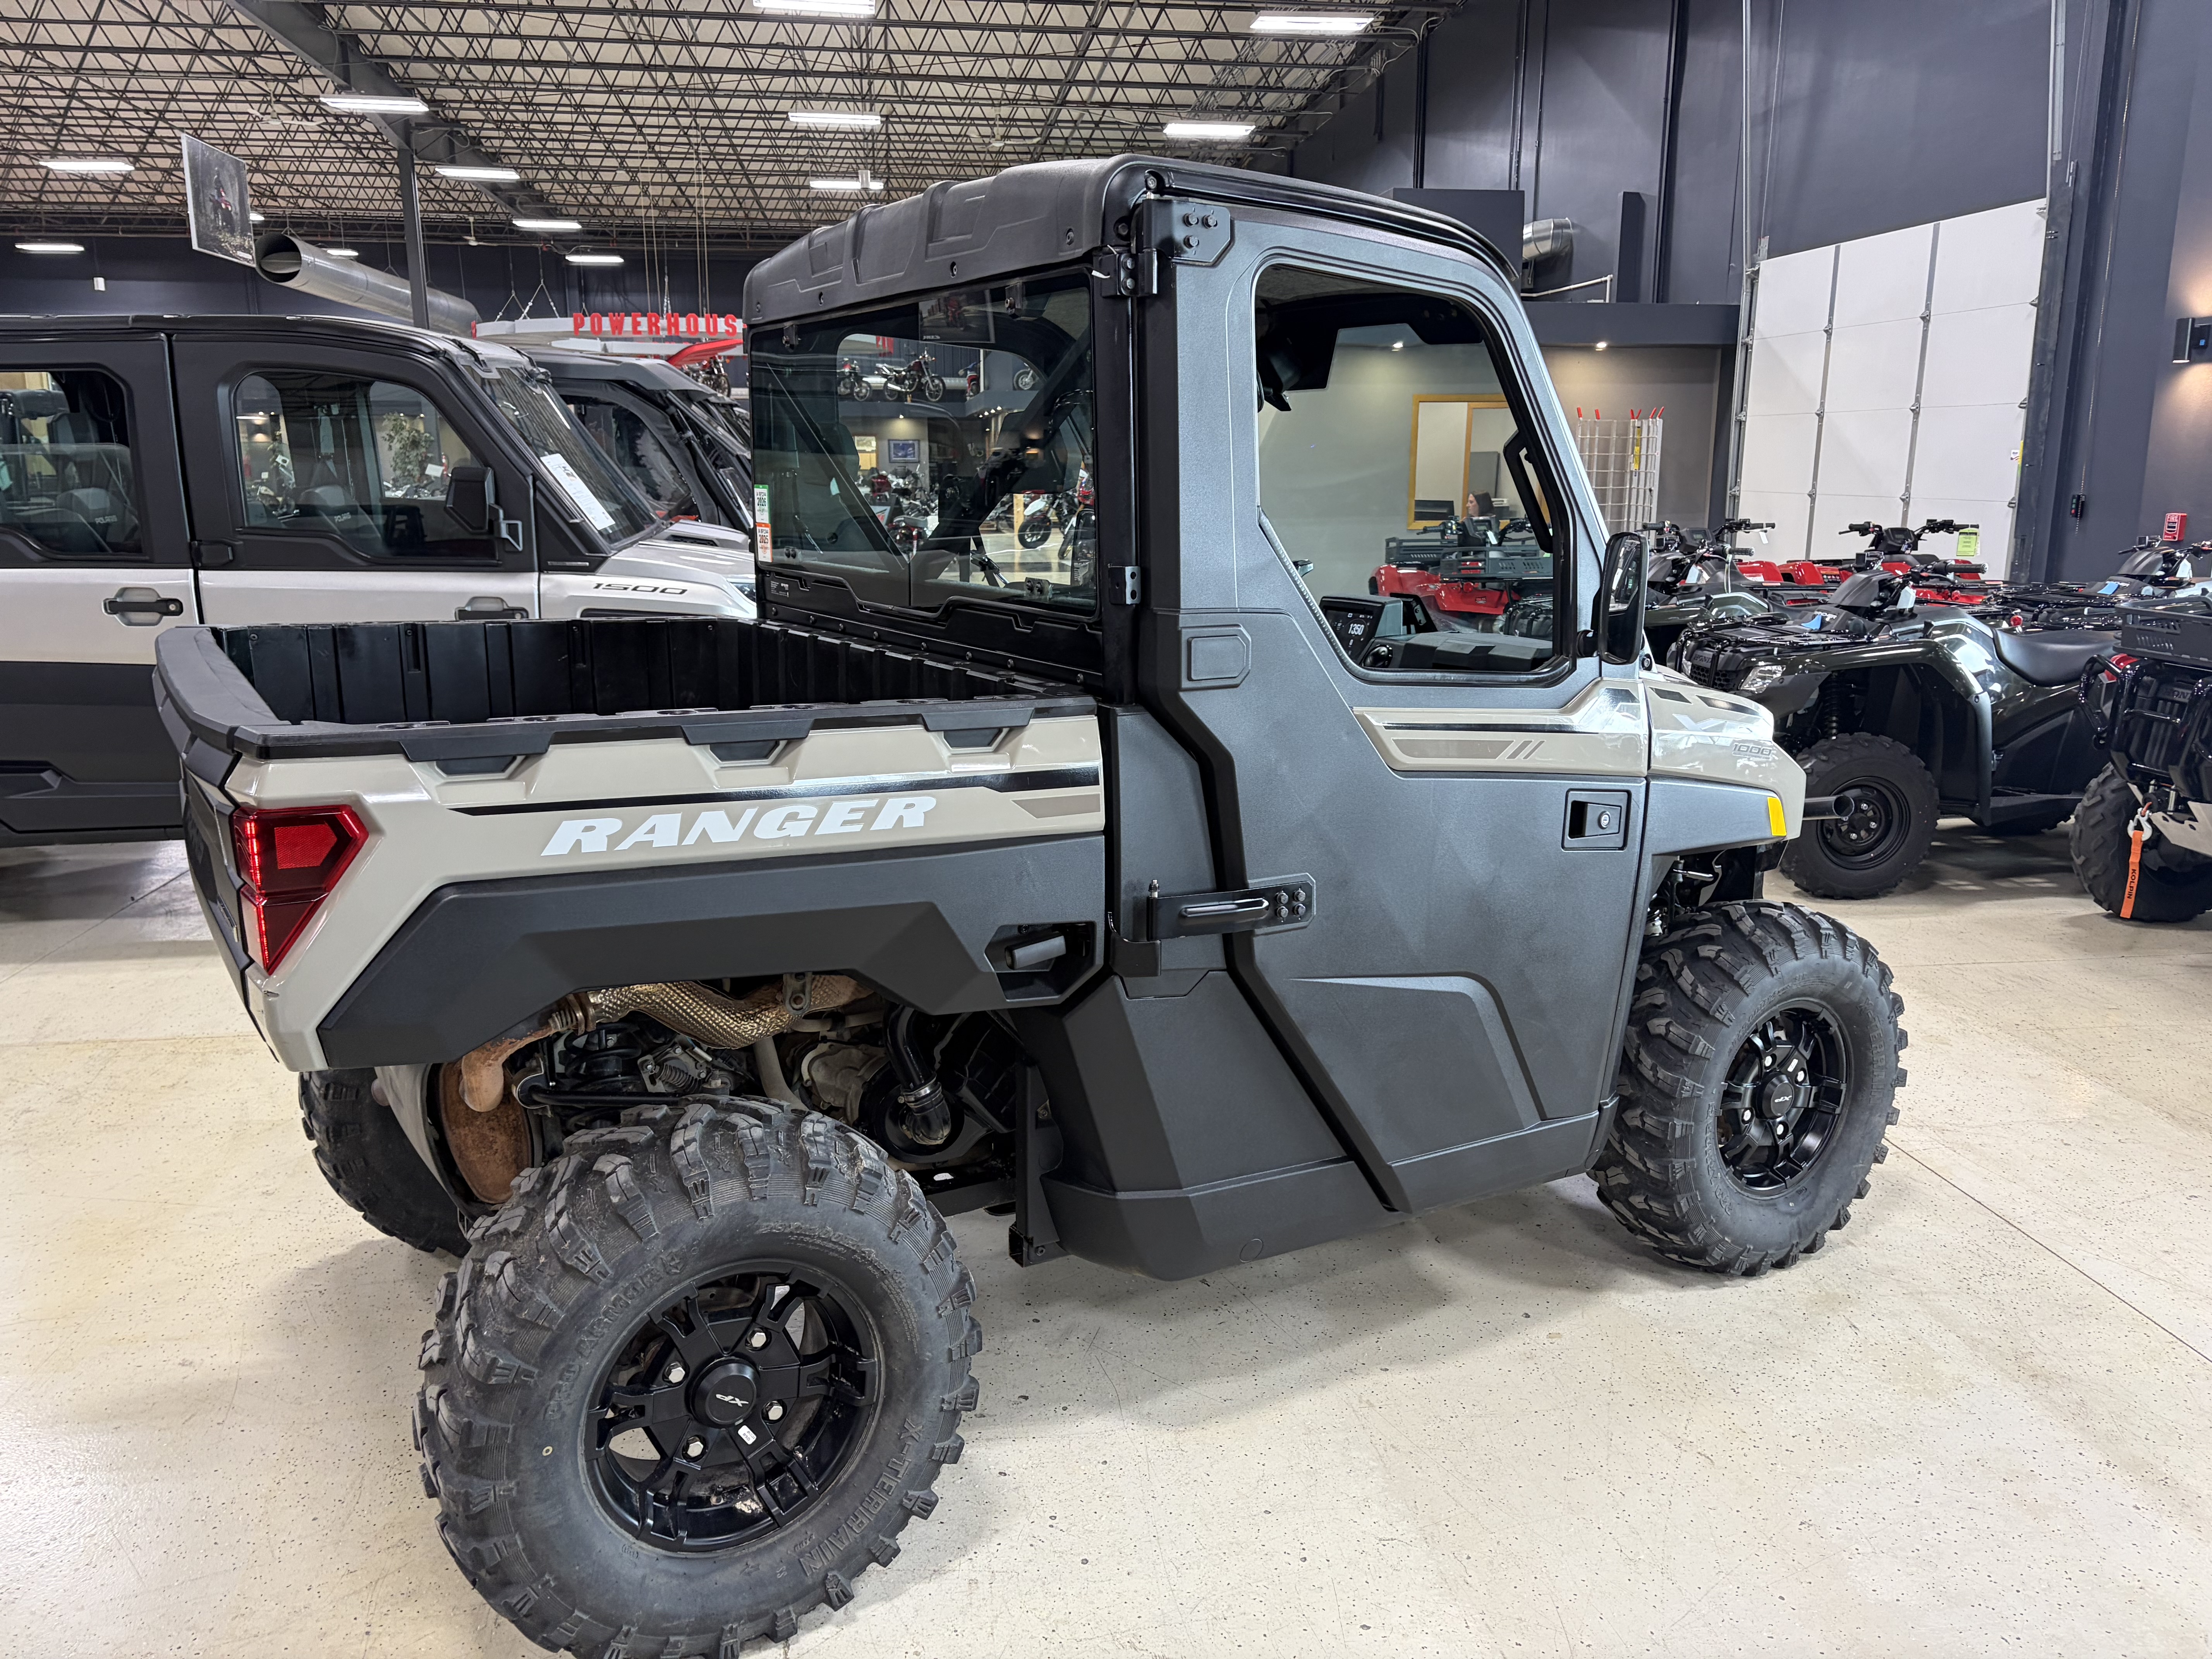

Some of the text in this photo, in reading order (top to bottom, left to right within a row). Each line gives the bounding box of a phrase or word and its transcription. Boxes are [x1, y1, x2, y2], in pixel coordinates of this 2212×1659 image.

[573, 313, 746, 337] POWERHOUS
[757, 497, 766, 507] 2026
[759, 534, 769, 544] 2025
[593, 583, 688, 594] 1500
[1348, 623, 1364, 635] 1350
[1693, 654, 1712, 663] HOND
[1733, 742, 1773, 756] 1000
[542, 795, 937, 856] RANGER
[2127, 869, 2136, 899] KOLPIN
[1855, 996, 1886, 1104] X-TERRAIN
[543, 1267, 664, 1420] PRO ARMOR
[716, 1394, 749, 1407] XP
[799, 1418, 924, 1577] X-TERRAIN
